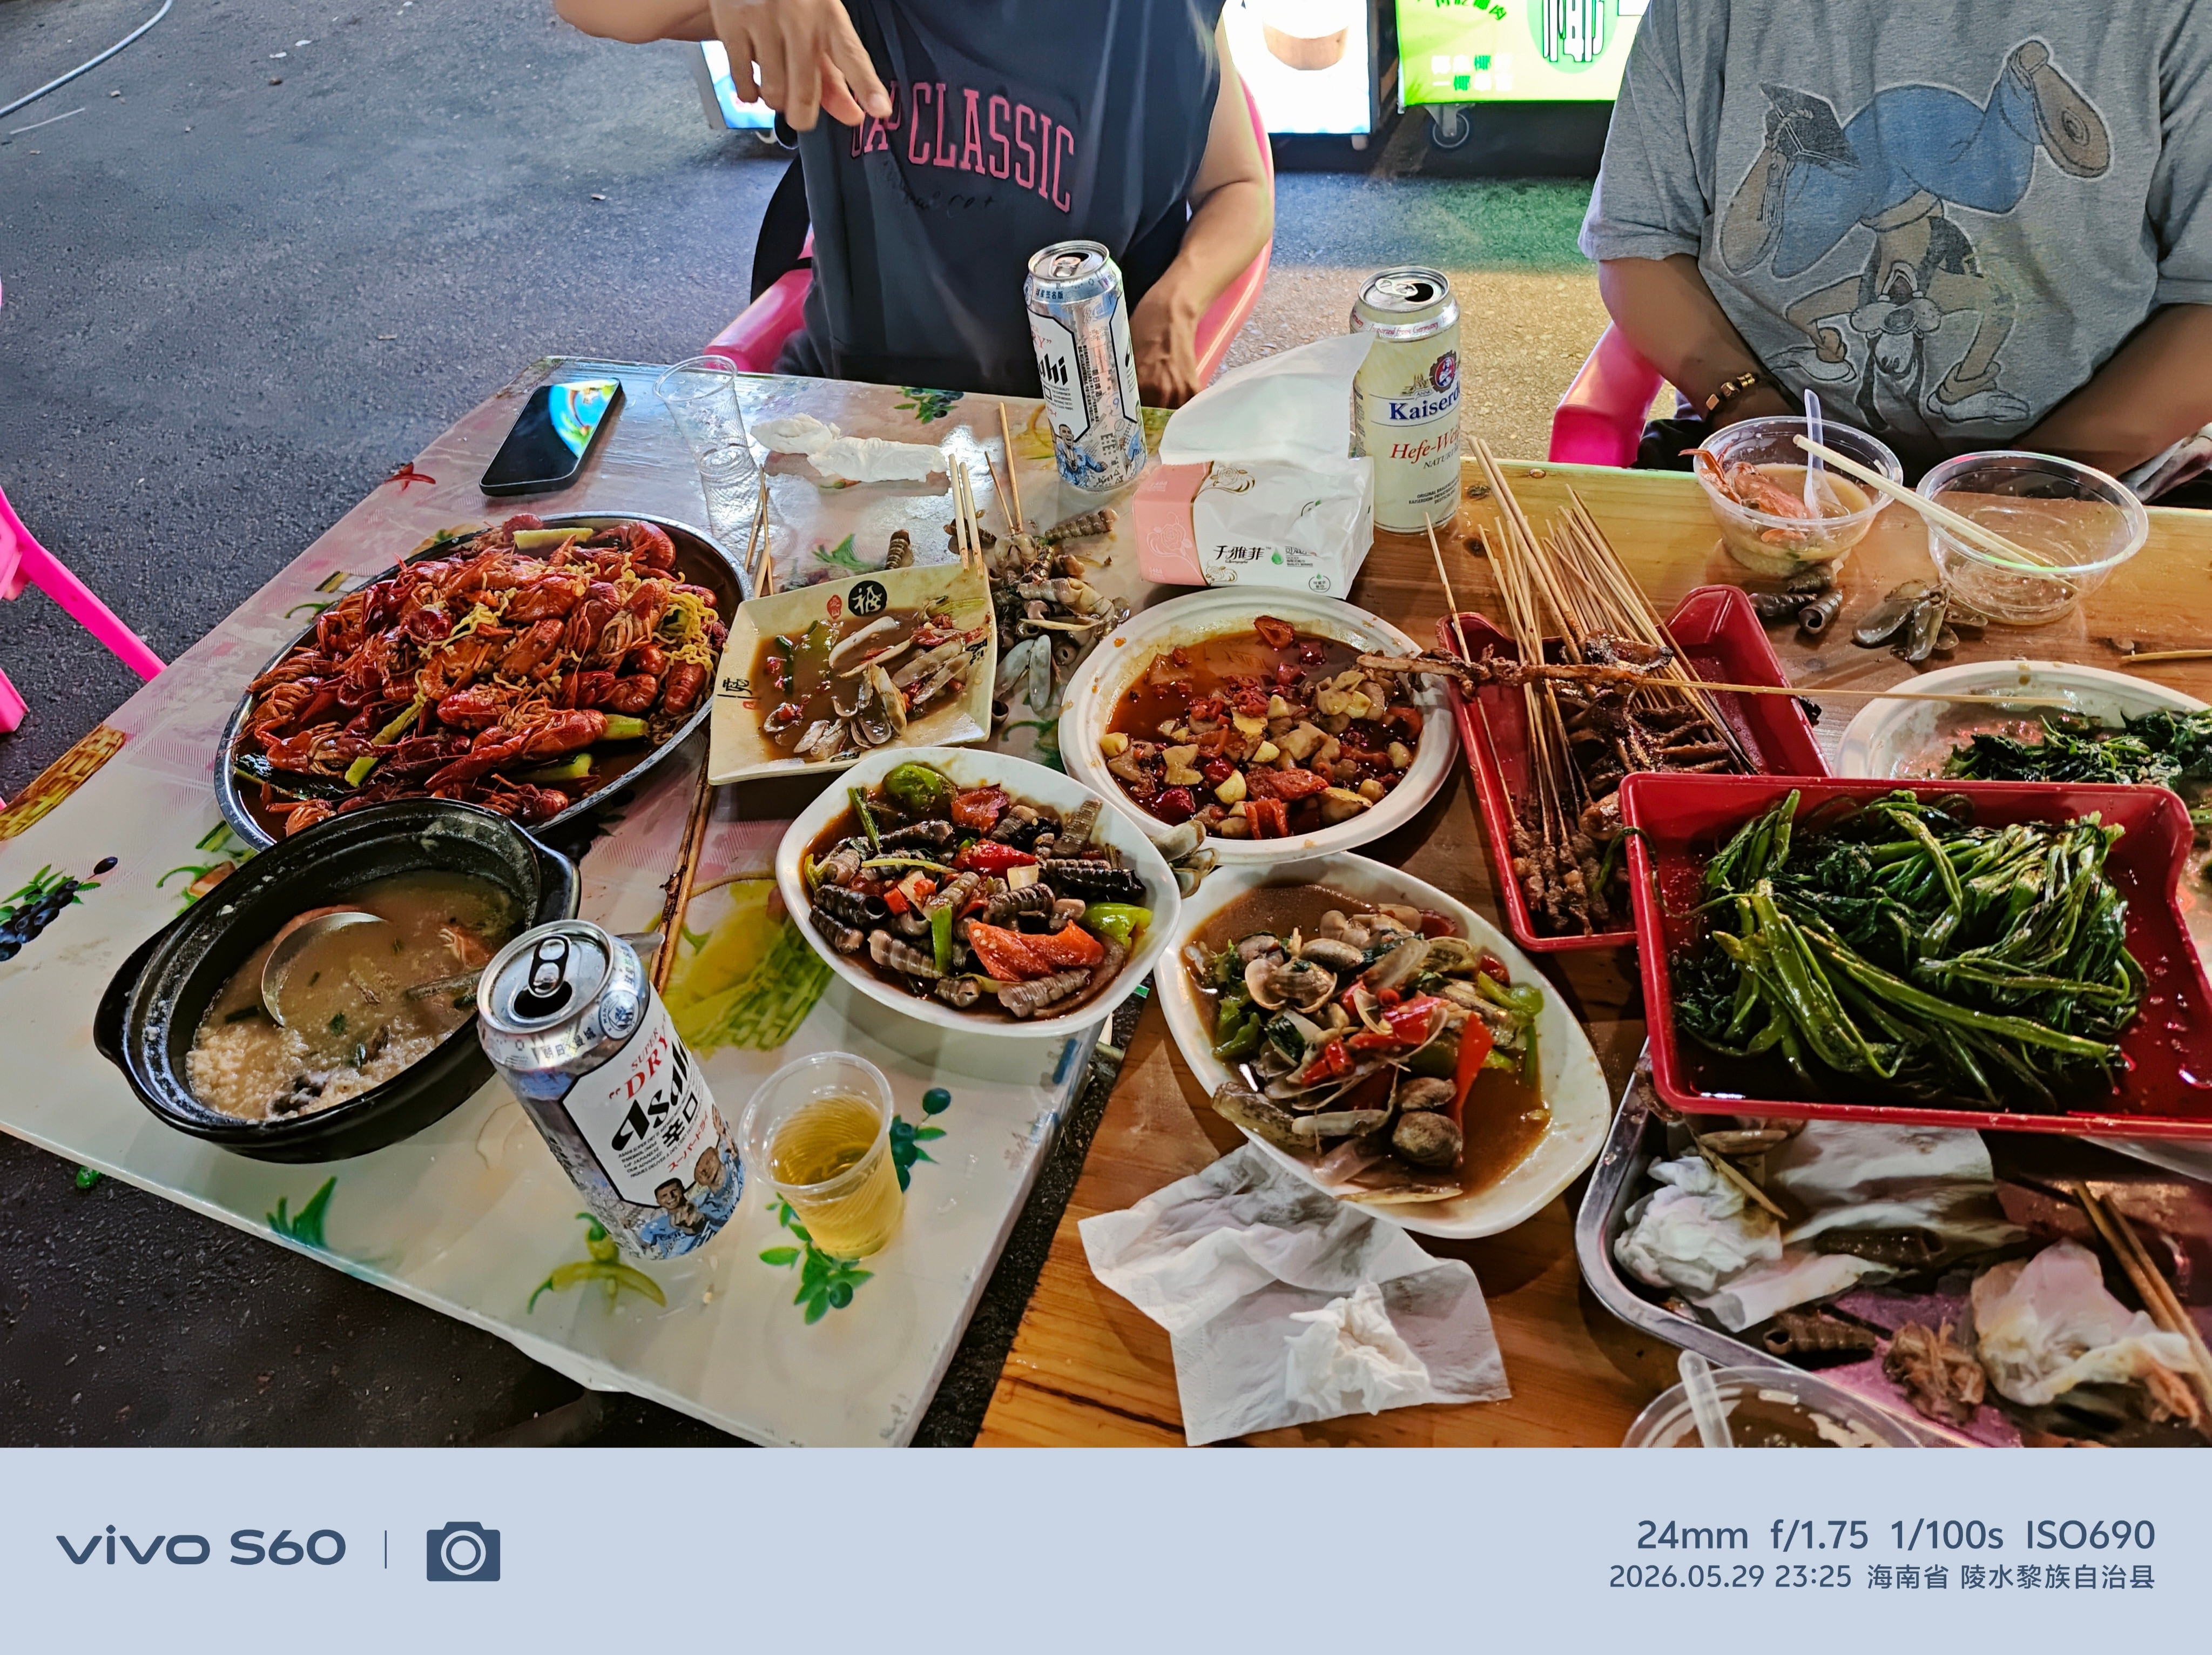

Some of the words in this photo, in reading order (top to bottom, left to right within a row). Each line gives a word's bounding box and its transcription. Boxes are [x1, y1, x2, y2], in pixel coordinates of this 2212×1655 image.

[908, 82, 1074, 213] CLASSIC
[1389, 380, 1460, 420] Kaiserd
[1213, 545, 1265, 560] 千雅菲
[631, 1027, 658, 1072] SUPER
[633, 1146, 659, 1165] JAPANESE
[648, 1157, 666, 1170] DELIVER
